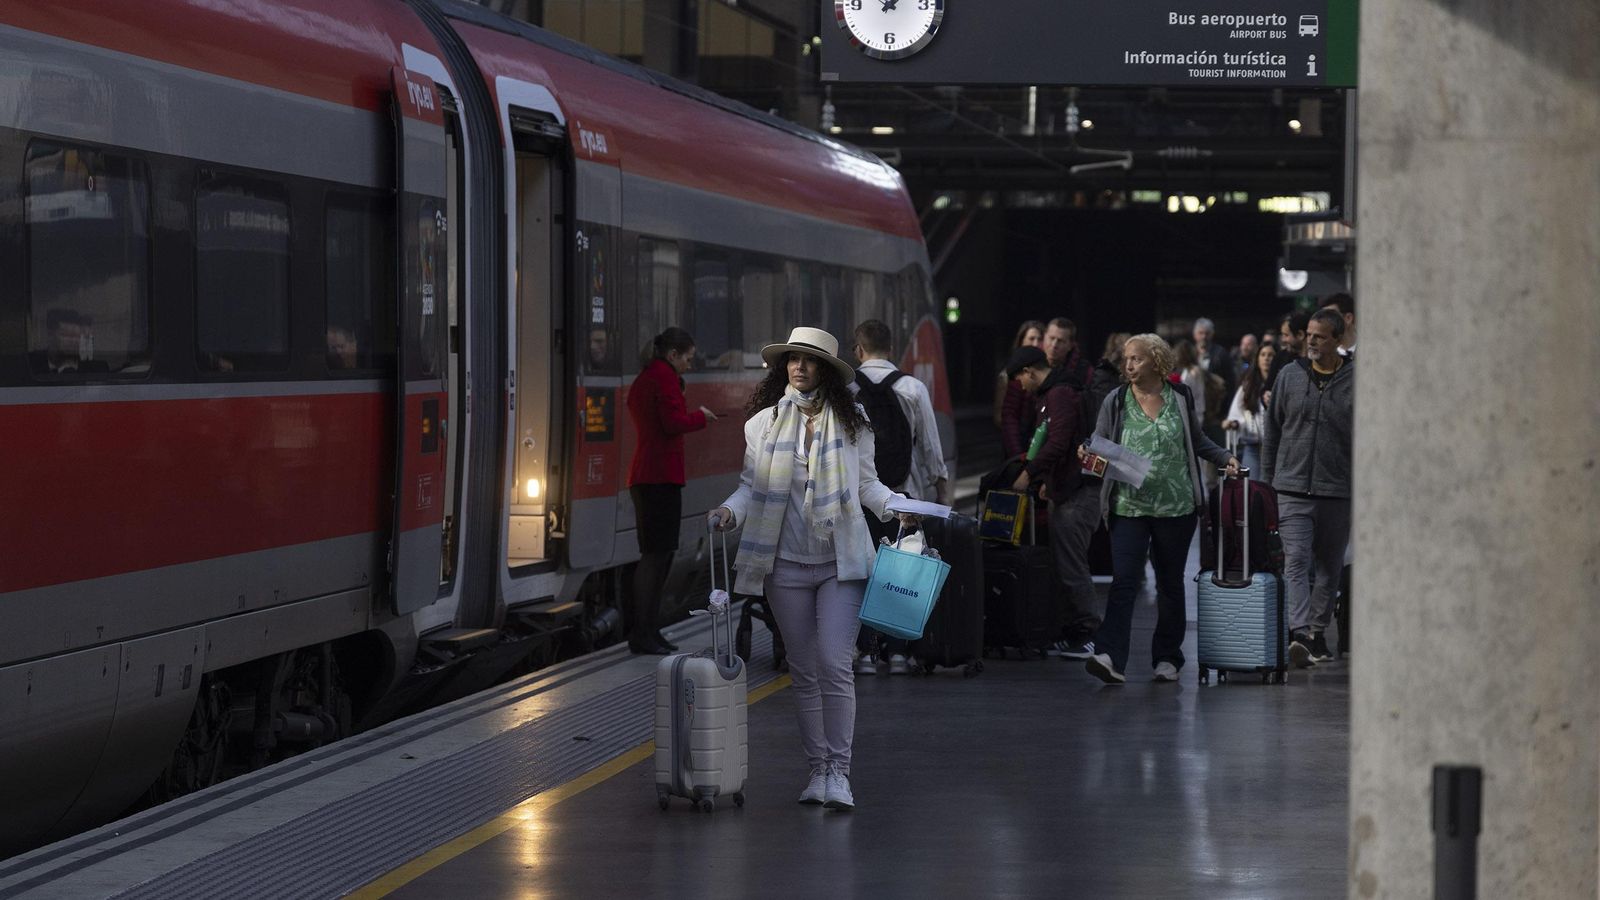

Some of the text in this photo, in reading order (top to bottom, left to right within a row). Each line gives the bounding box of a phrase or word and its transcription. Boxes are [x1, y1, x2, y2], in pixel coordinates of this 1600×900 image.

[851, 0, 862, 10] 9
[918, 0, 929, 10] 3
[1168, 12, 1287, 28] Bus aeropuerto
[884, 33, 896, 44] 6
[1229, 30, 1287, 39] AIRPORT BUS
[1124, 51, 1287, 66] Información turística
[1188, 69, 1287, 78] TOURIST INFORMATION
[882, 582, 919, 598] Aromas
